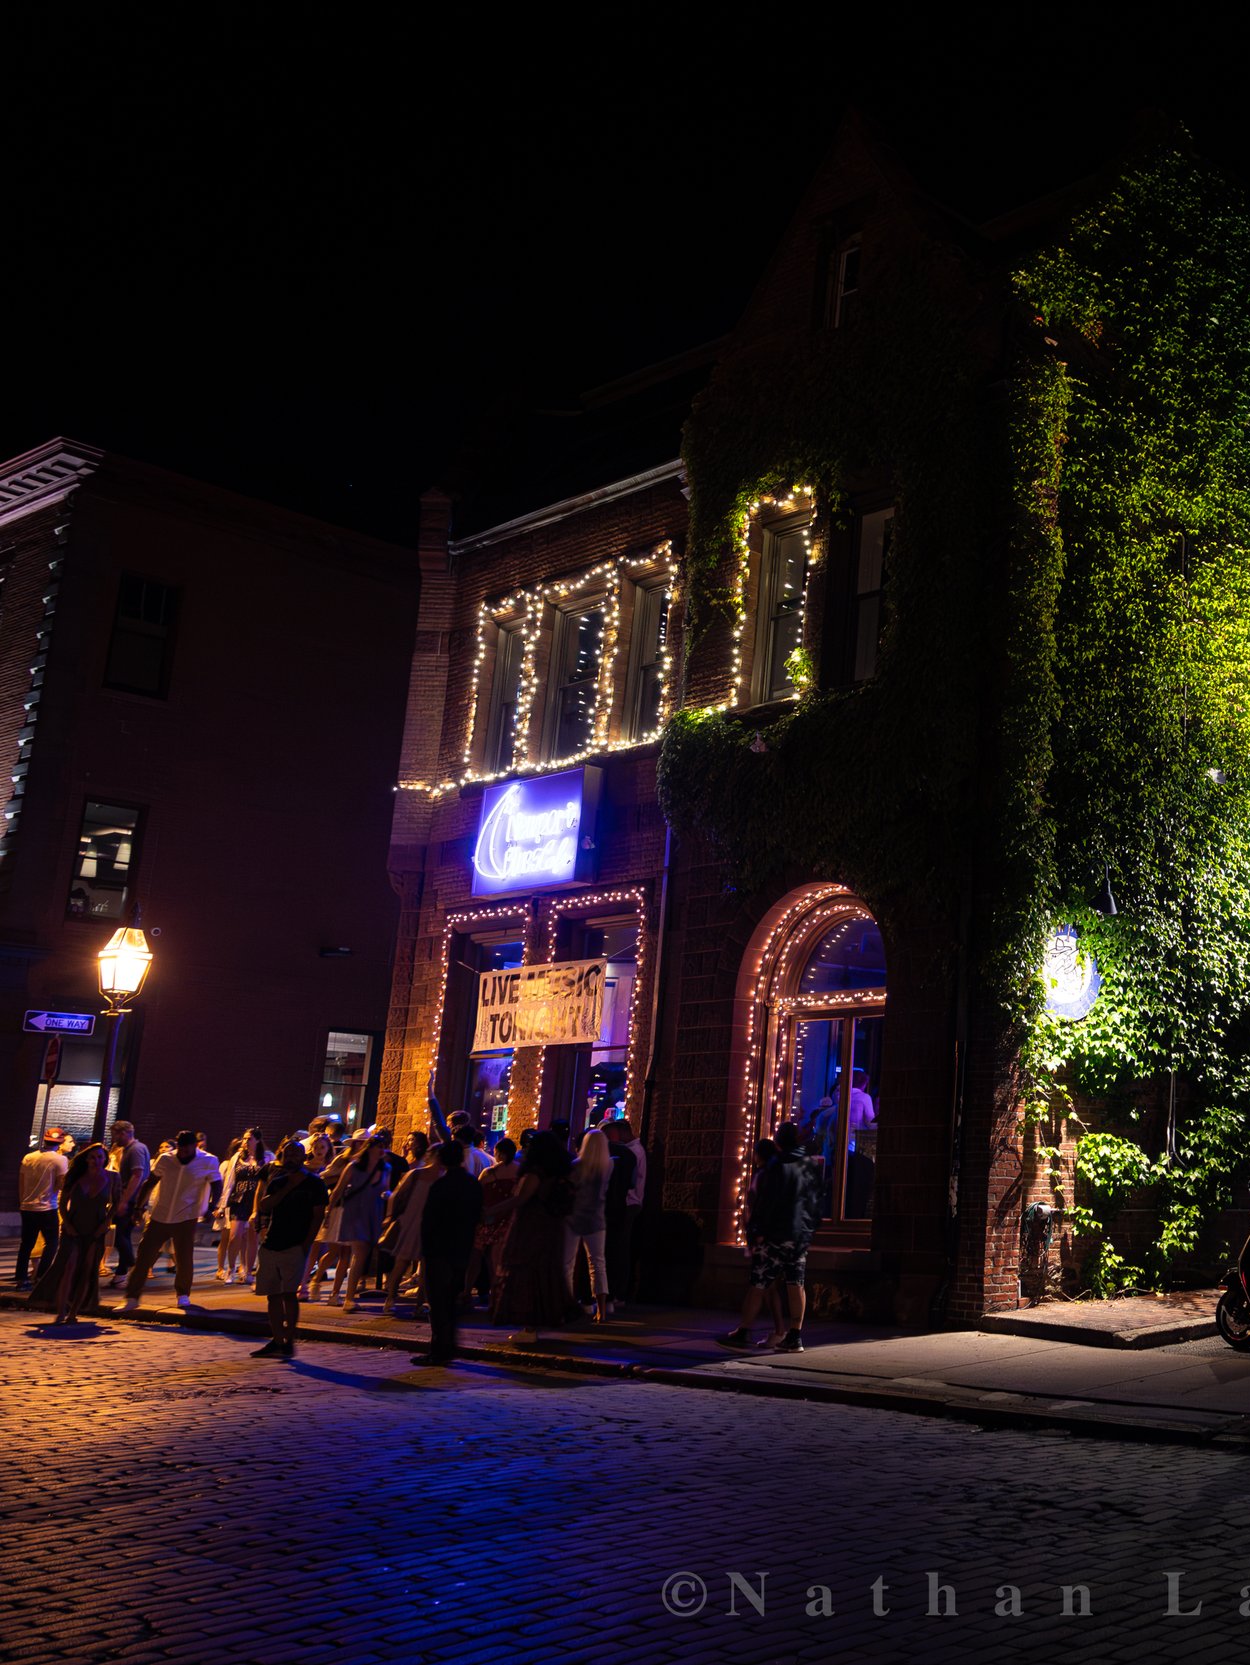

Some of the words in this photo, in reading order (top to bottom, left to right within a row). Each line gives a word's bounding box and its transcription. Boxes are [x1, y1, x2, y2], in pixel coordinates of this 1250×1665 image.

[481, 973, 520, 1007] LIVE
[45, 1018, 64, 1027] ONE
[67, 1019, 87, 1029] WAY
